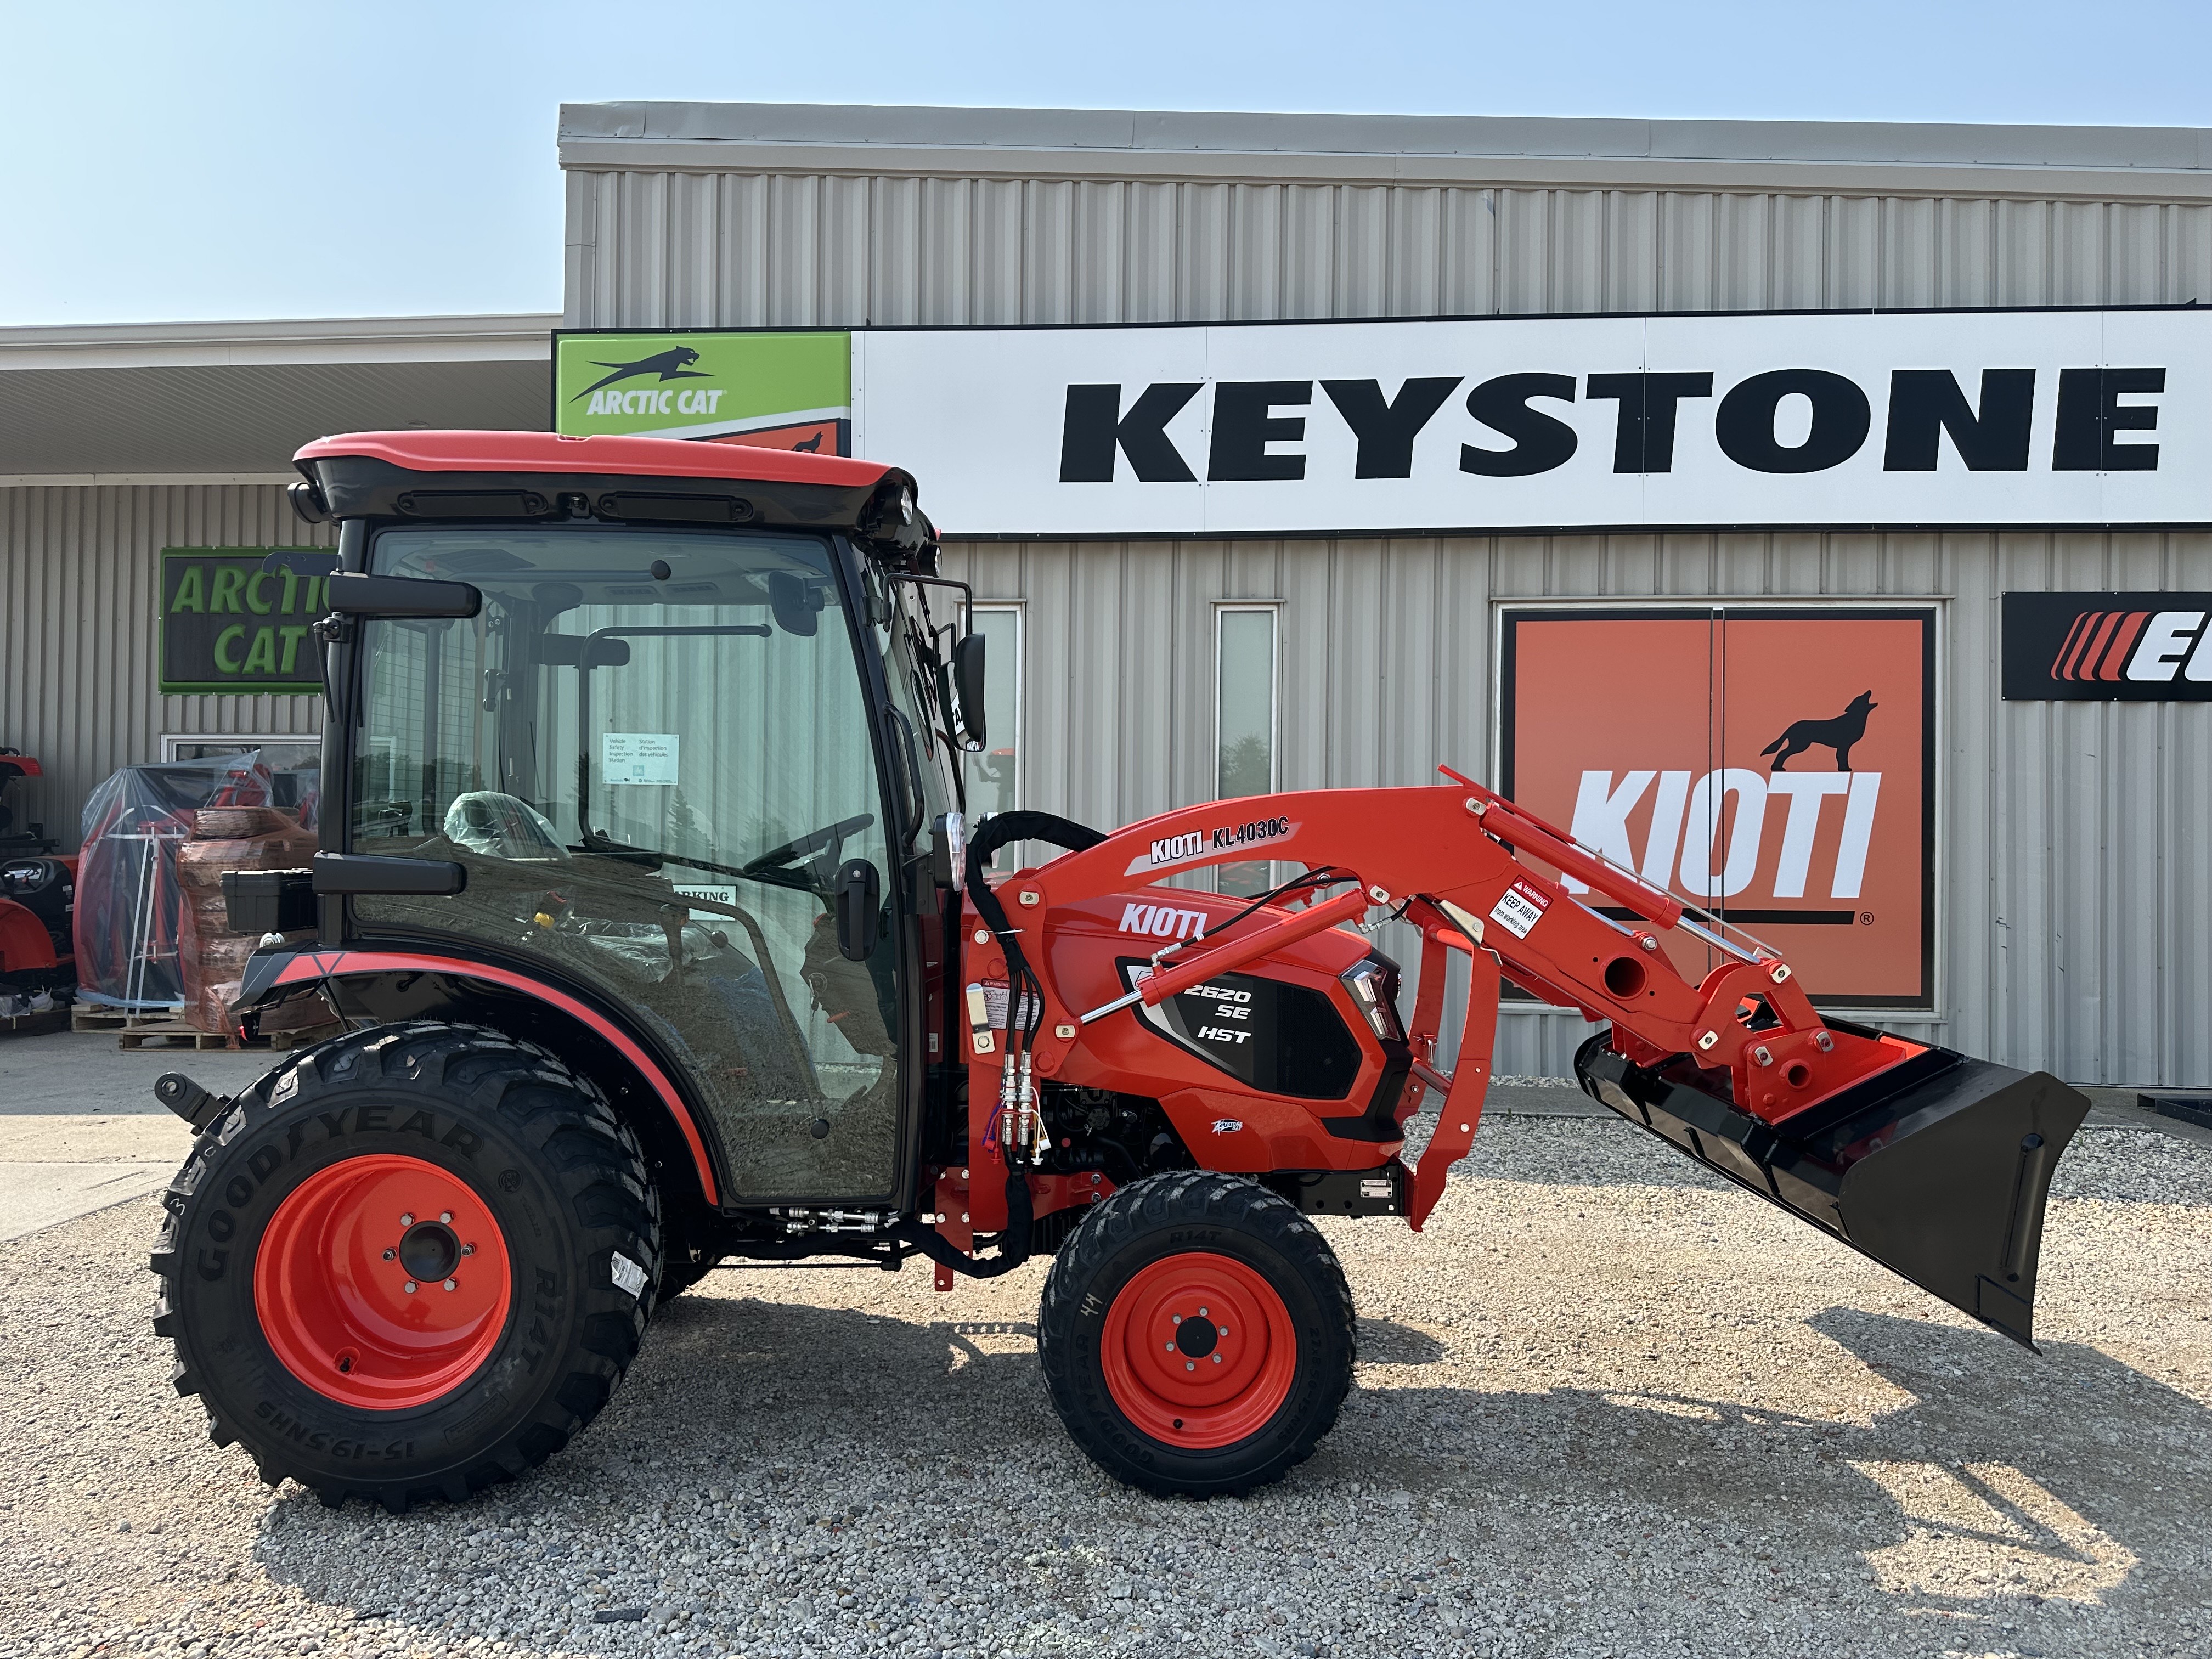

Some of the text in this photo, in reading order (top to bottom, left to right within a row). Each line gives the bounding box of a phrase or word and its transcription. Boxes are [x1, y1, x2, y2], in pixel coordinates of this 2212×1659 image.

[586, 390, 723, 415] ARCTIC CAT
[1059, 367, 2166, 483] KEYSTONE
[170, 565, 330, 616] ARCTI
[214, 623, 309, 675] CAT
[1150, 815, 1290, 865] KIOTI KL4030C
[1558, 768, 1882, 899] KIOTI
[1502, 892, 1539, 923] KEEP AWAY
[1522, 885, 1549, 907] WARNING
[1118, 903, 1208, 939] KIOTI
[1494, 906, 1528, 934] from working area
[1184, 985, 1251, 1003] 2620
[1215, 1005, 1251, 1020] SE
[1197, 1026, 1252, 1043] HST
[198, 1104, 485, 1282] GOODYEAR
[1170, 1230, 1222, 1244] R14T
[522, 1266, 557, 1376] R14T
[1075, 1334, 1155, 1465] GOODYEAR
